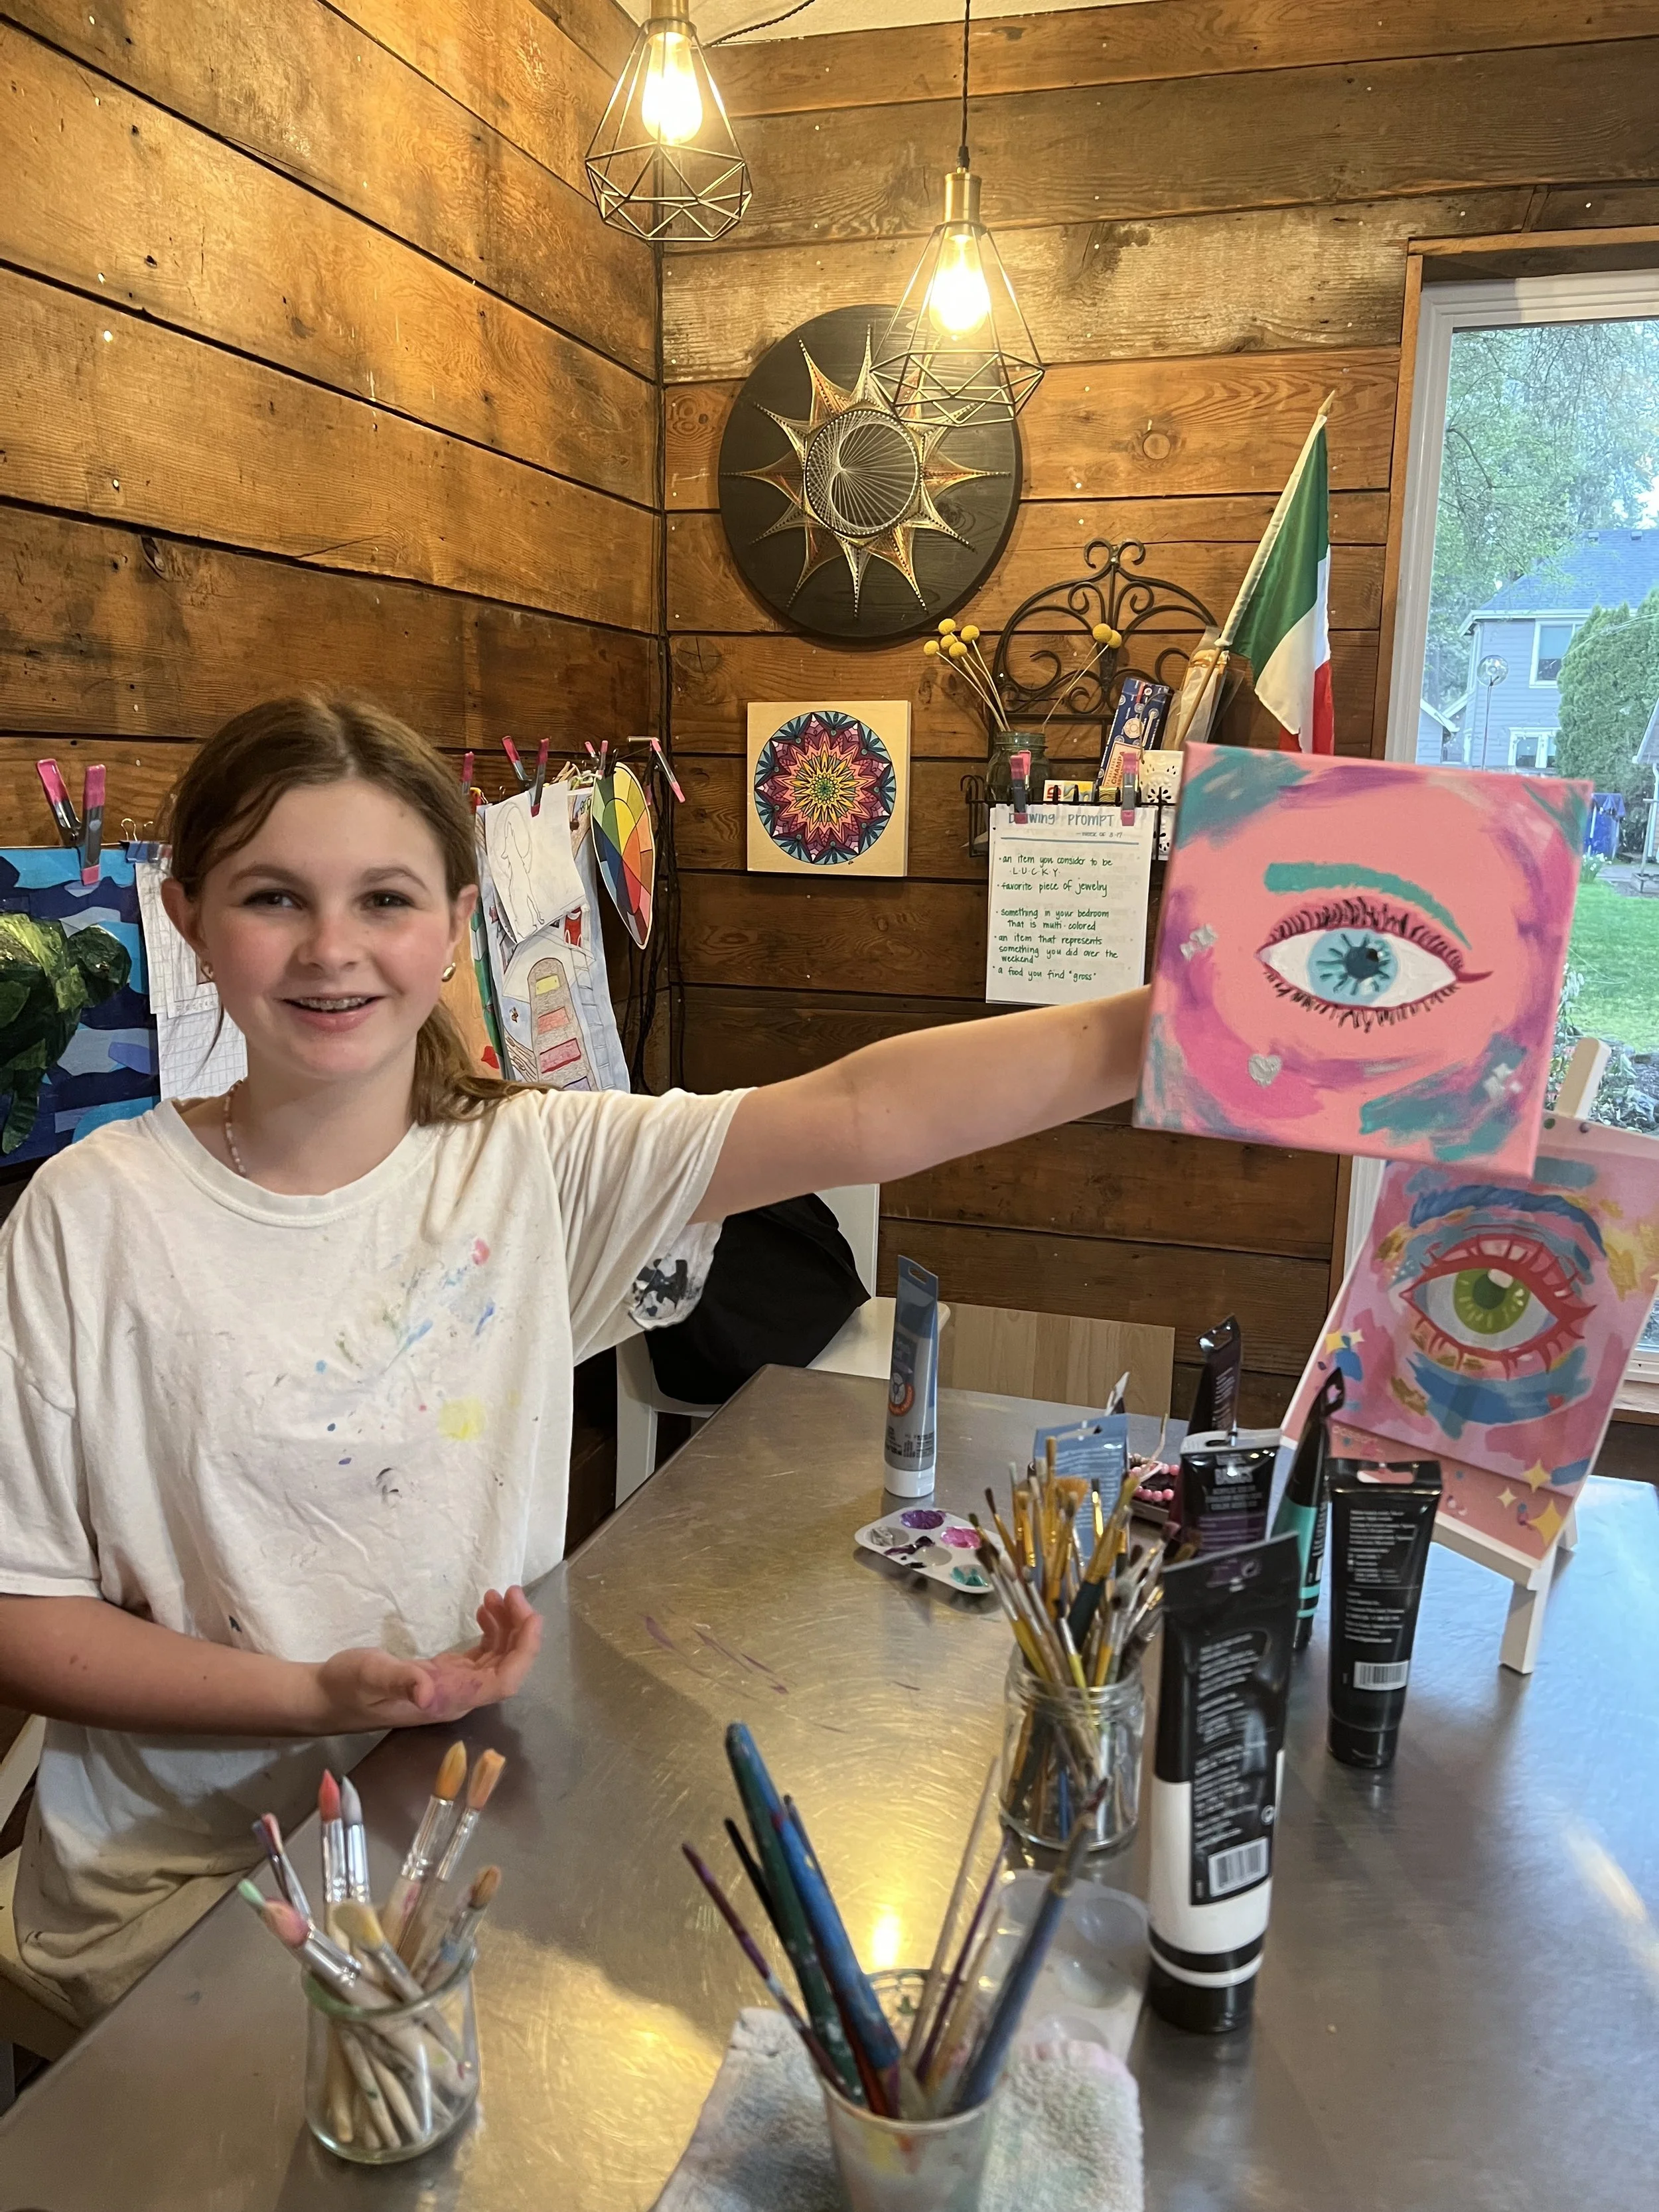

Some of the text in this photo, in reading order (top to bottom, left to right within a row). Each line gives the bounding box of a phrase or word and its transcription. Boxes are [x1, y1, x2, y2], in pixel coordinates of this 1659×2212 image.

[1111, 751, 1125, 784] CHAMPA
[1009, 812, 1055, 825] Dwing
[1018, 854, 1035, 863] item
[1040, 857, 1054, 868] you
[1056, 857, 1086, 865] consider
[1090, 857, 1098, 866] to
[1001, 877, 1108, 898] favorite piece of jewelry
[1001, 907, 1110, 920] something in your bedroom
[1007, 919, 1024, 928] that
[1029, 919, 1037, 928] is
[1014, 932, 1032, 942] item
[1038, 934, 1056, 944] that
[1061, 936, 1103, 947] represents
[999, 944, 1039, 958] something
[1046, 949, 1062, 960] you
[1065, 947, 1078, 956] did
[1105, 949, 1119, 959] the
[1001, 955, 1034, 964] weekend
[1008, 966, 1023, 977] food
[1028, 970, 1043, 982] you
[1047, 969, 1065, 980] find
